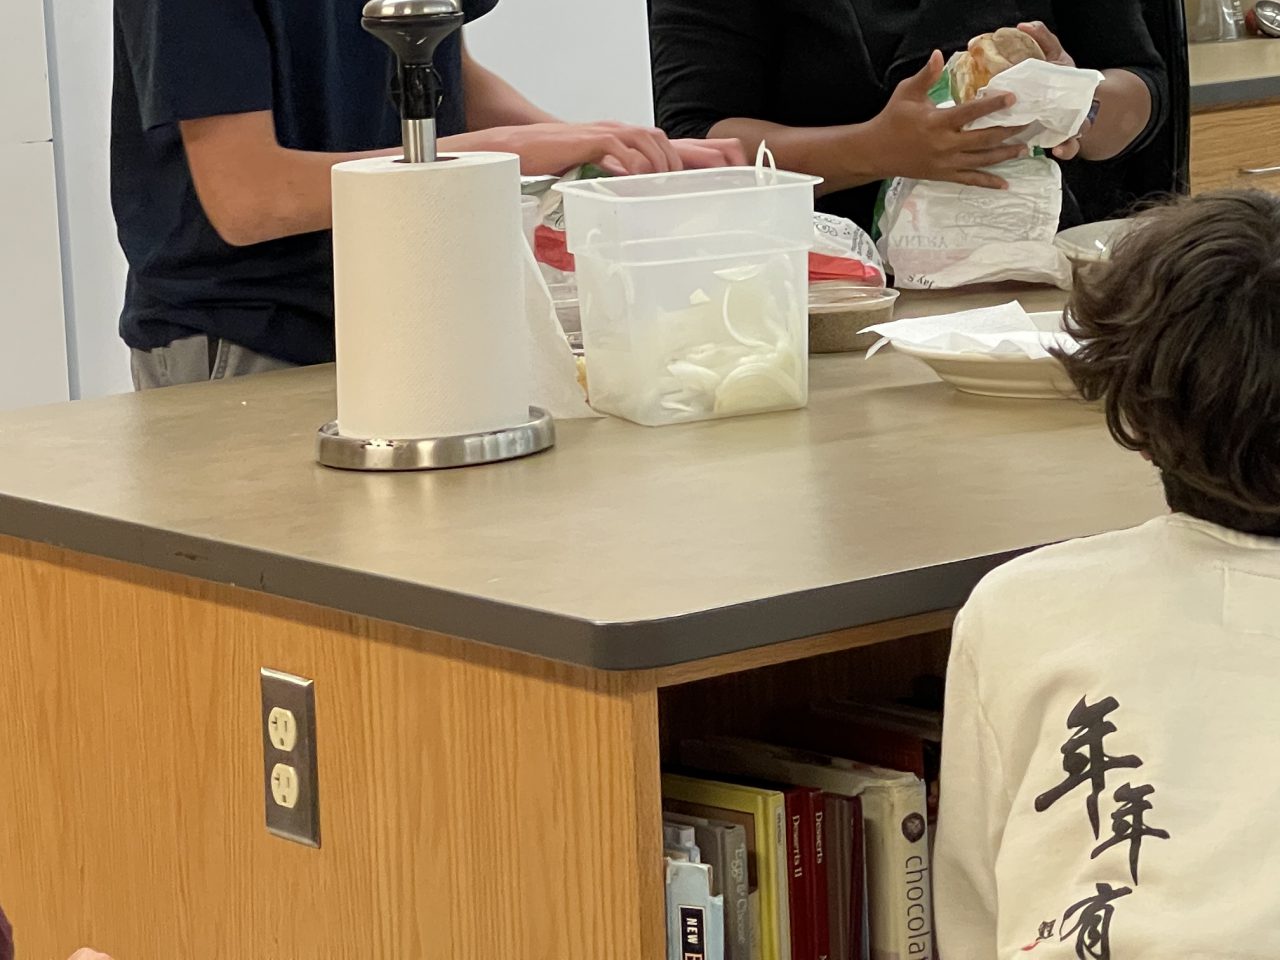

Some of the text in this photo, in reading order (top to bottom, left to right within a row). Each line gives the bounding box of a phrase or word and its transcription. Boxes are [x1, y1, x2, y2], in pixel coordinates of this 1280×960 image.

[792, 814, 802, 866] Desserts
[815, 811, 824, 864] Desserts
[1034, 693, 1171, 960] 年年有
[686, 917, 699, 945] NEW
